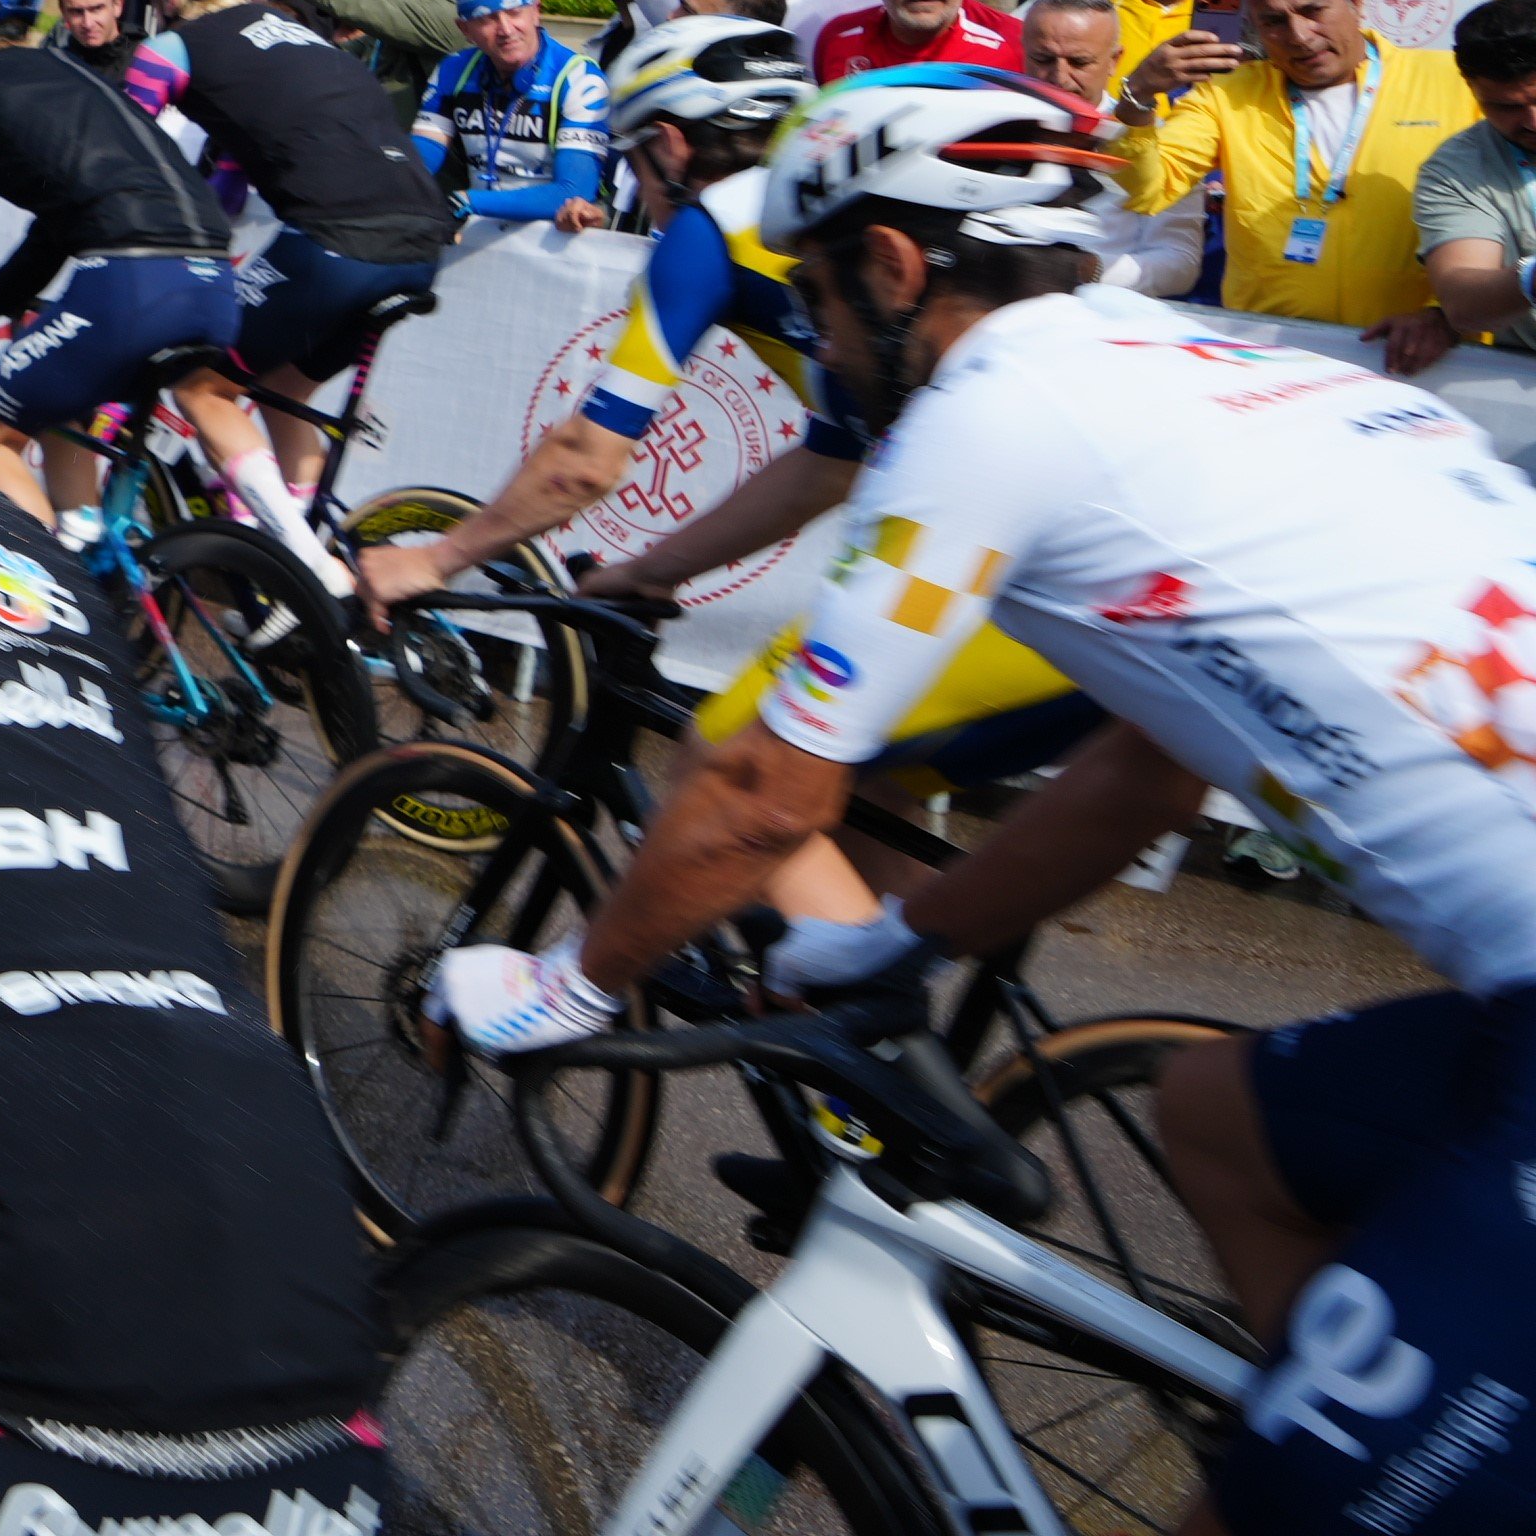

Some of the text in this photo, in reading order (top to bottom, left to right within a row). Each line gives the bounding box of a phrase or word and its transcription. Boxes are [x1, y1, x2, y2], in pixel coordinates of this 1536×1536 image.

[452, 107, 544, 140] GAIN
[0, 311, 93, 381] ASTANA
[724, 389, 765, 467] CULTURE
